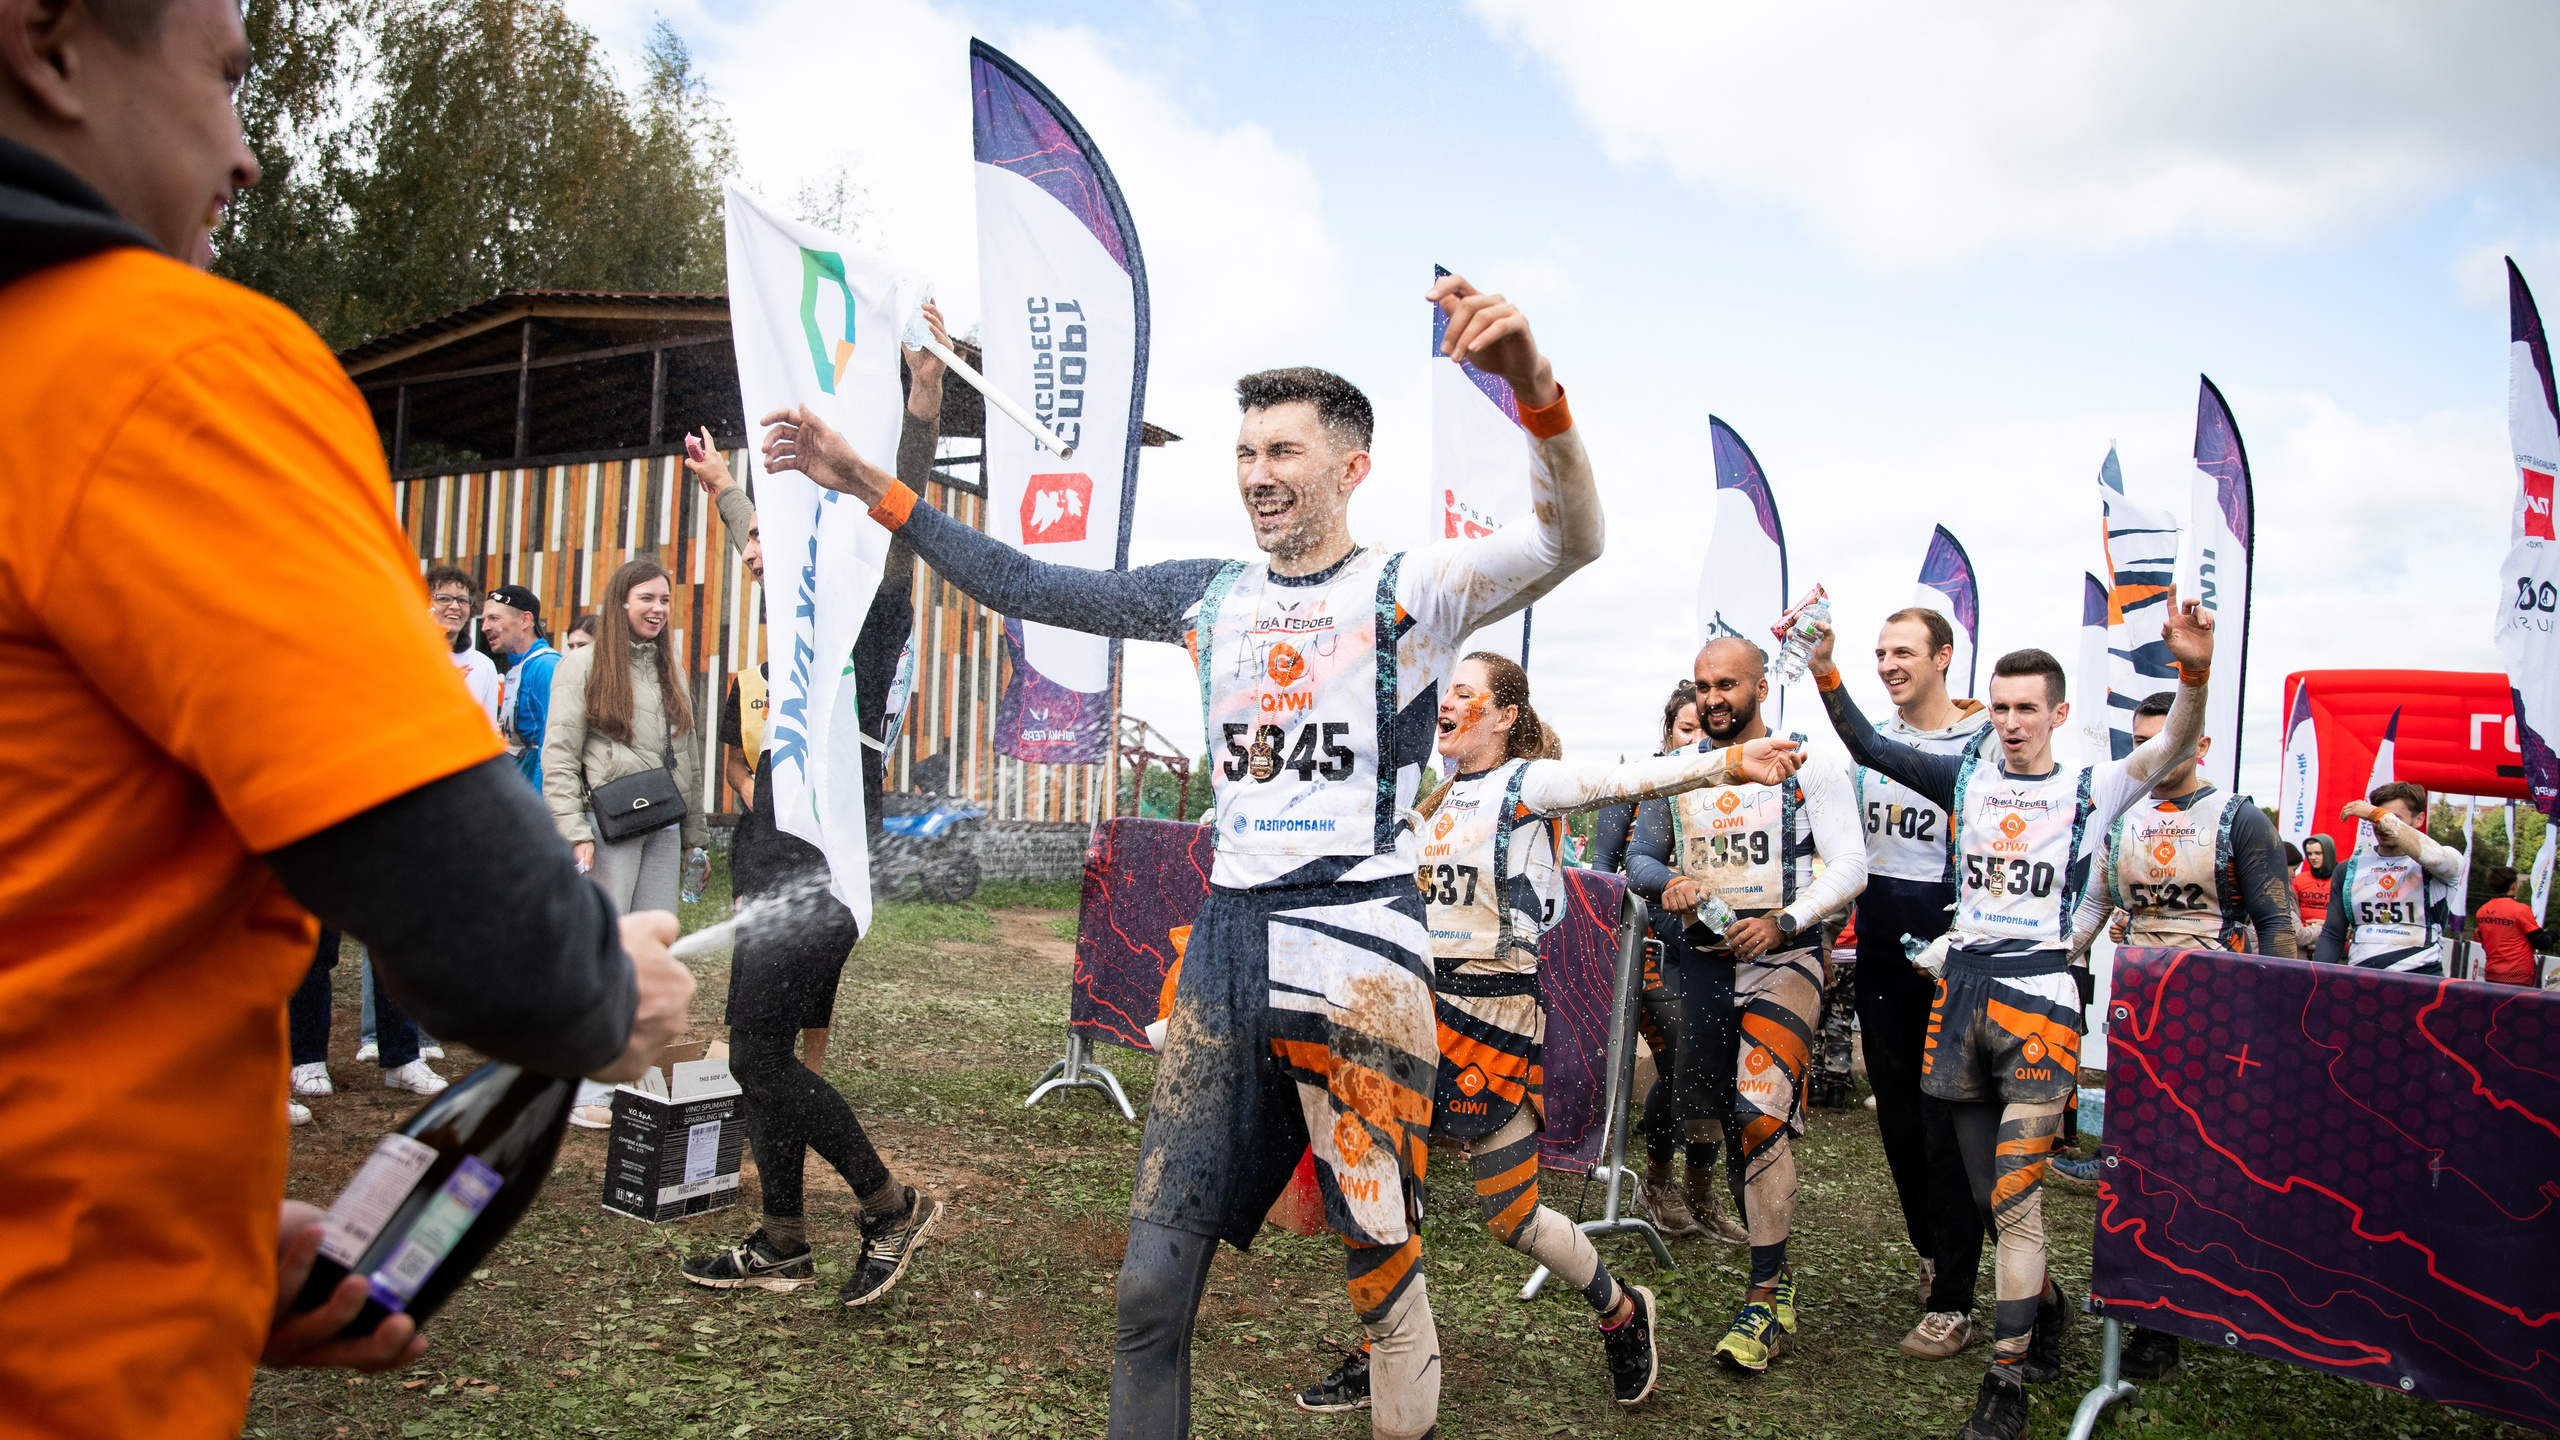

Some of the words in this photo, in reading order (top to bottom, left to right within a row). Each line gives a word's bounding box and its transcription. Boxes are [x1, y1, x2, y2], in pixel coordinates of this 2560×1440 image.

[1284, 616, 1333, 630] ГЕРОЕВ
[1261, 692, 1313, 712] QIWI
[2294, 753, 2307, 833] ГАЗПАНК
[1987, 796, 2013, 805] ГОНКА
[2015, 799, 2048, 808] ГЕРОЕВ
[1254, 819, 1336, 832] ГАЗПРОМБАНК
[1712, 816, 1744, 829] QIWI
[1867, 801, 1936, 842] 5102
[2142, 828, 2163, 836] ГОНКА
[1424, 843, 1451, 857] QIWI
[1690, 830, 1769, 871] 5359
[1992, 840, 2029, 852] QIWI
[1967, 853, 2055, 898] 5530
[2149, 867, 2177, 878] QIWI
[1714, 885, 1764, 895] ГАЗПРОМБАНК
[2376, 891, 2399, 899] QIWI
[1984, 913, 2039, 927] ГАЗПРОМБАНК
[2361, 902, 2415, 924] 5351
[1429, 929, 1472, 940] ПРОМБАНК
[2014, 1067, 2051, 1082] QIWI
[1739, 1080, 1773, 1095] QIWI
[685, 1104, 700, 1114] VINO
[701, 1099, 735, 1111] SPUMANTE
[1448, 1099, 1488, 1116] QIWI
[684, 1112, 718, 1125] SPARKLING
[1338, 1171, 1379, 1203] QIWI
